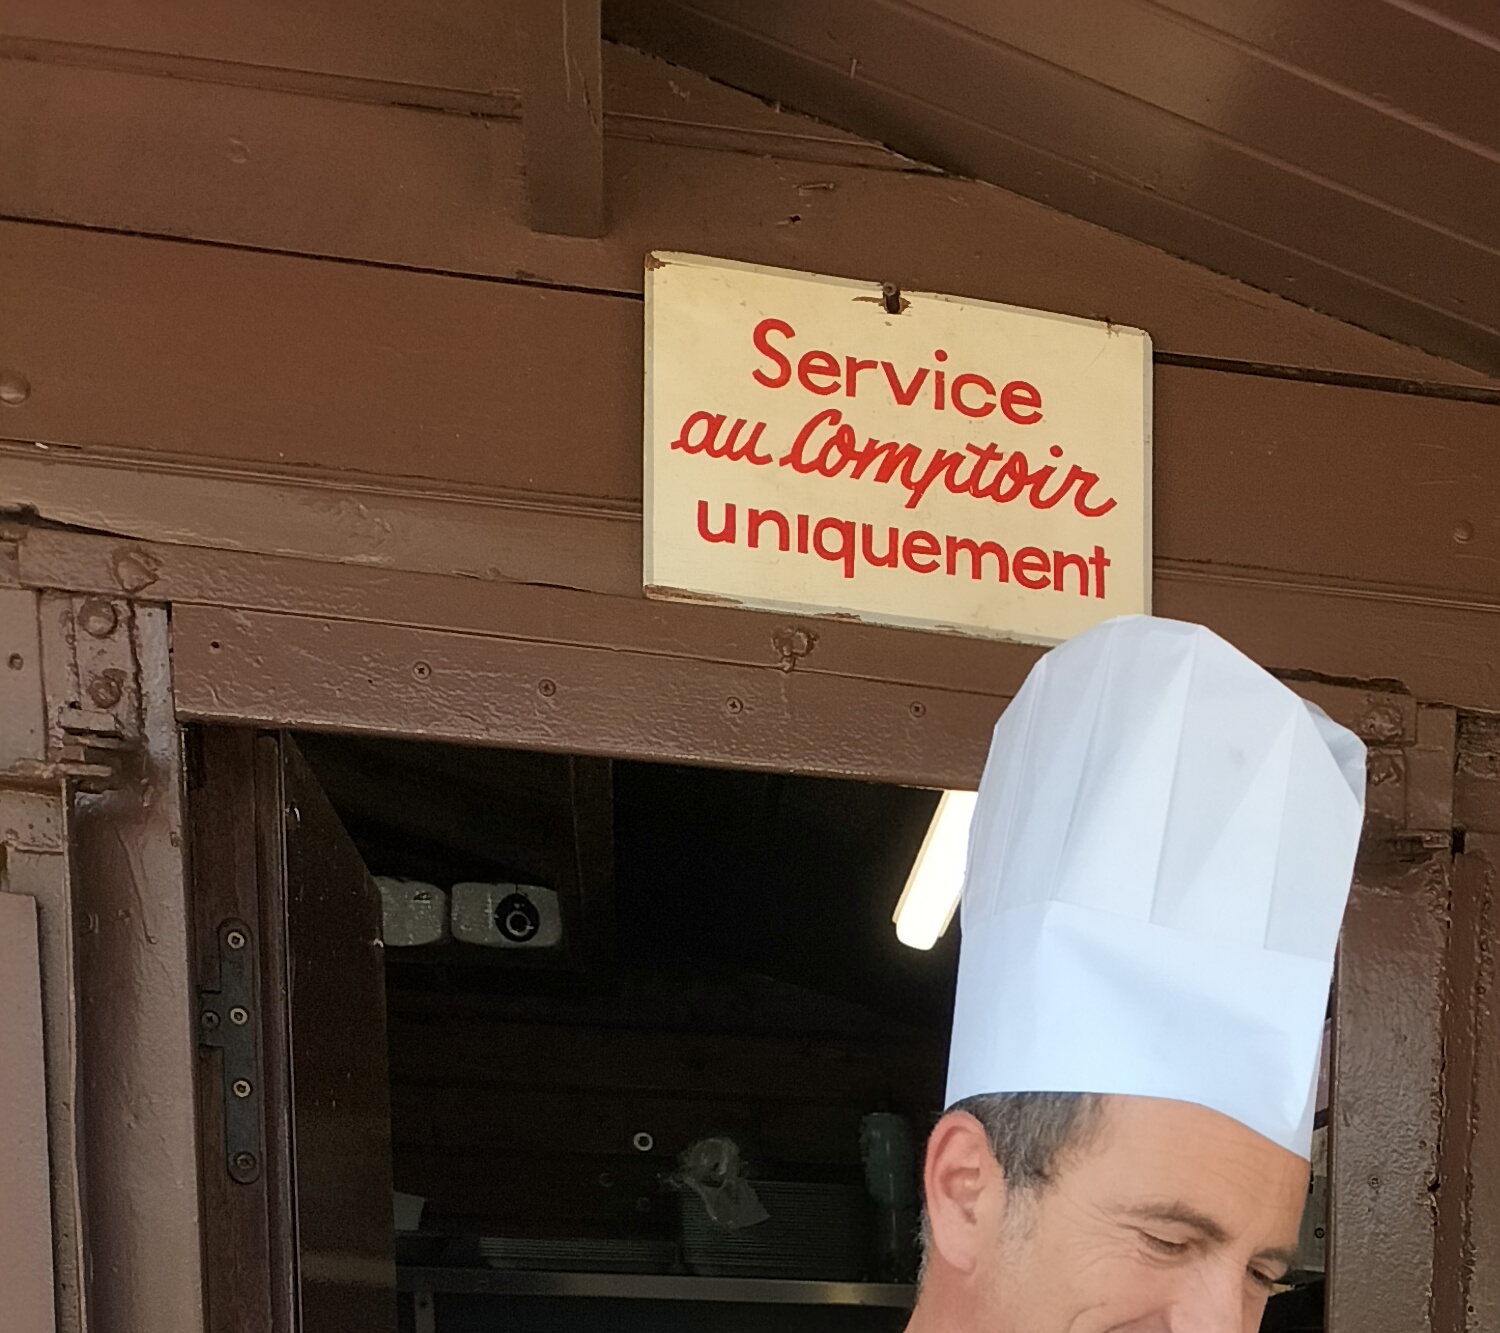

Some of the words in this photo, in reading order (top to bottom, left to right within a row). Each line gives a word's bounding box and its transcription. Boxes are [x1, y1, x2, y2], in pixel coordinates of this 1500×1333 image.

[751, 317, 1043, 426] Service
[670, 410, 774, 466] au
[779, 408, 1118, 518] Comptoir
[697, 500, 1110, 599] uniquement
